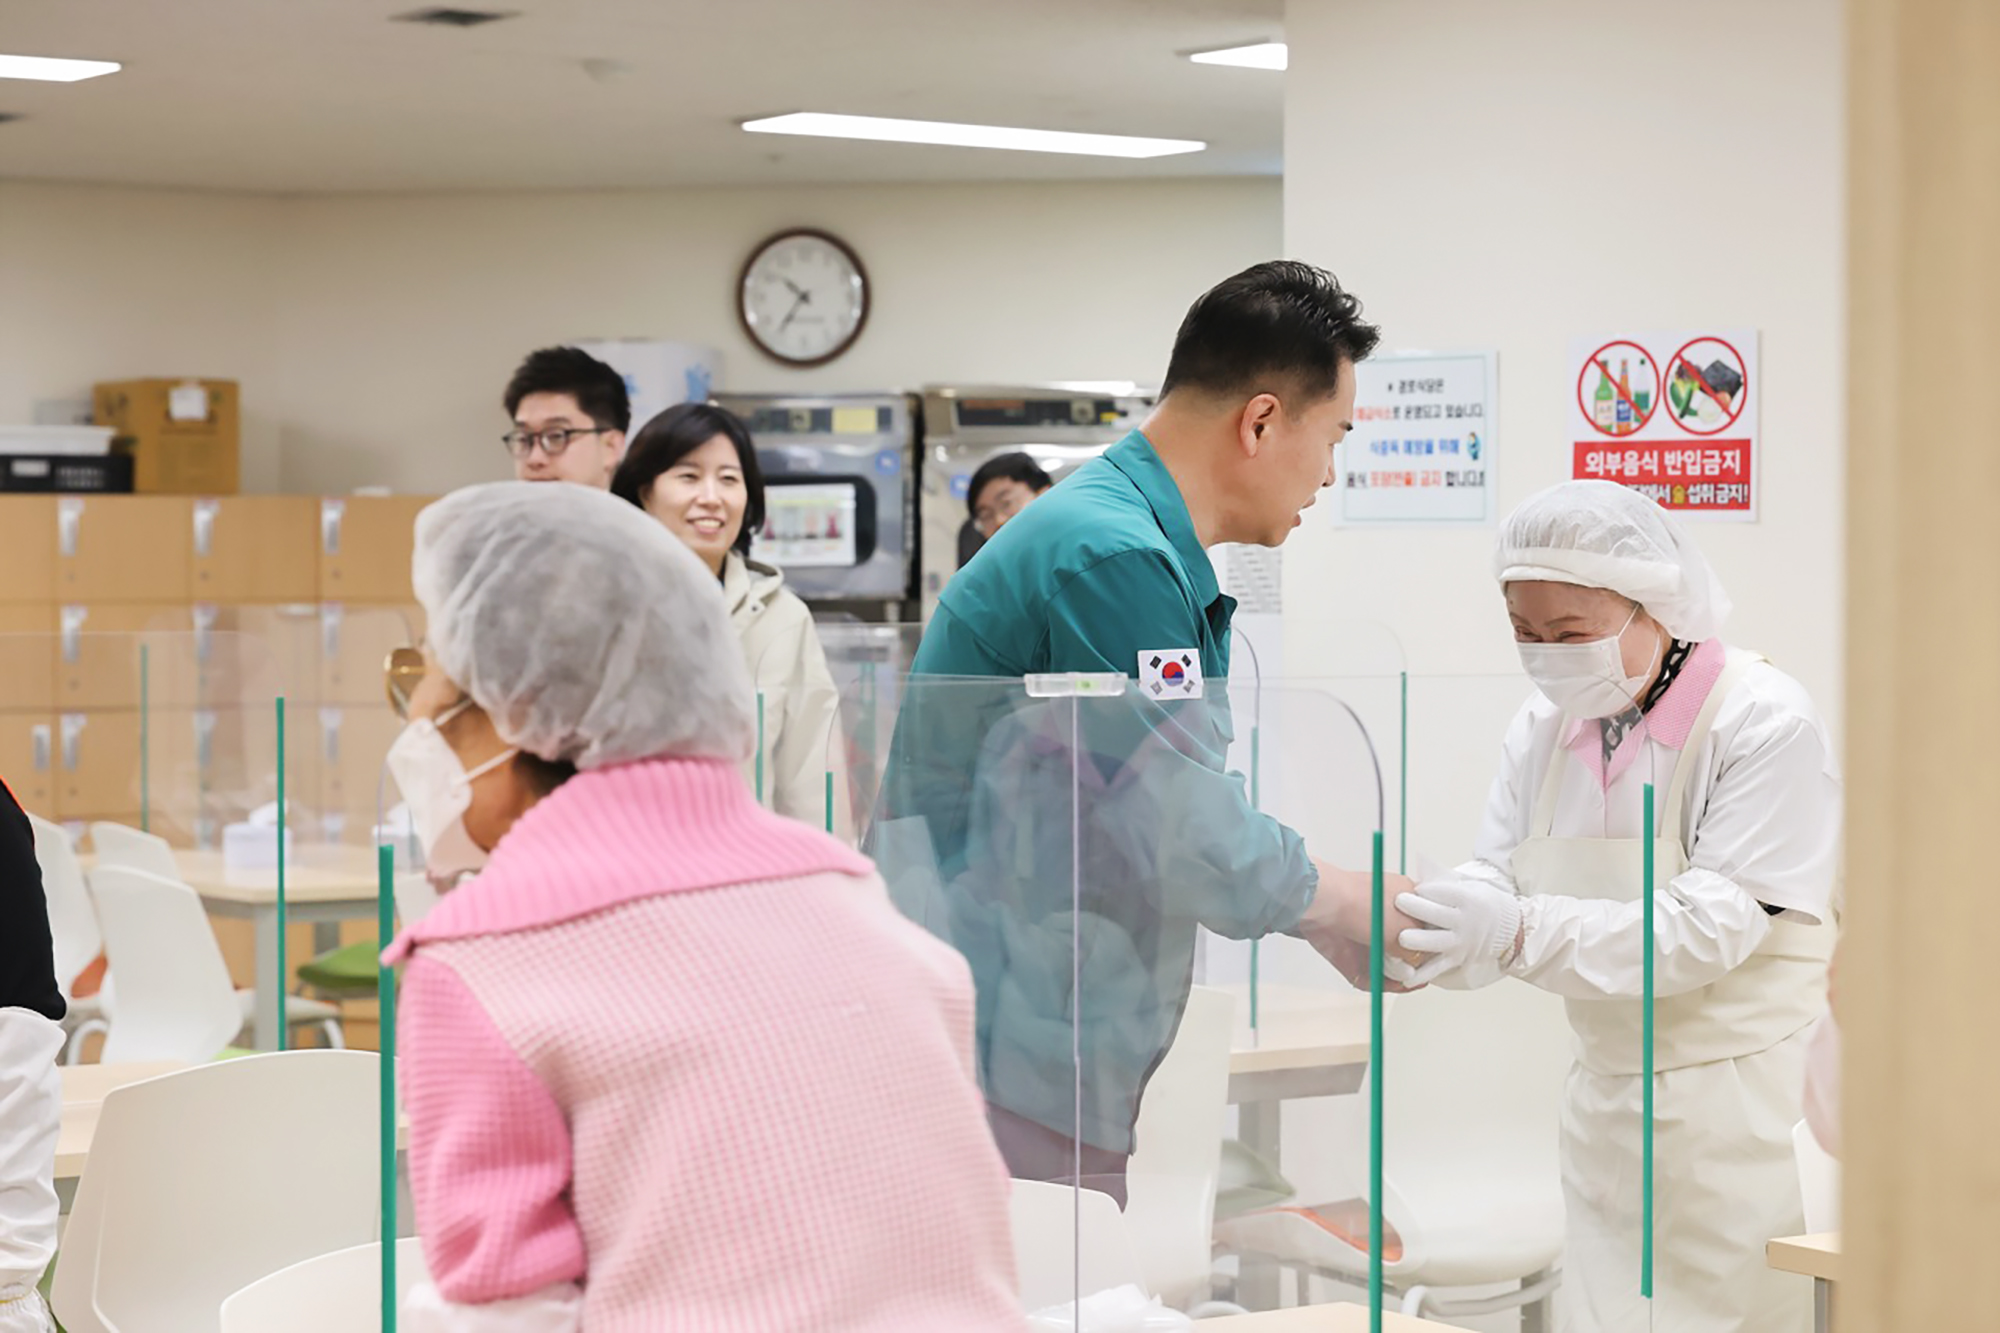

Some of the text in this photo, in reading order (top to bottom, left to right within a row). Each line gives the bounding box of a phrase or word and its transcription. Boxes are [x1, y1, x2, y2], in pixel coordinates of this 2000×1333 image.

[1584, 449, 1741, 475] 외부음식 반입금지
[1688, 484, 1748, 504] 섭취금지!
